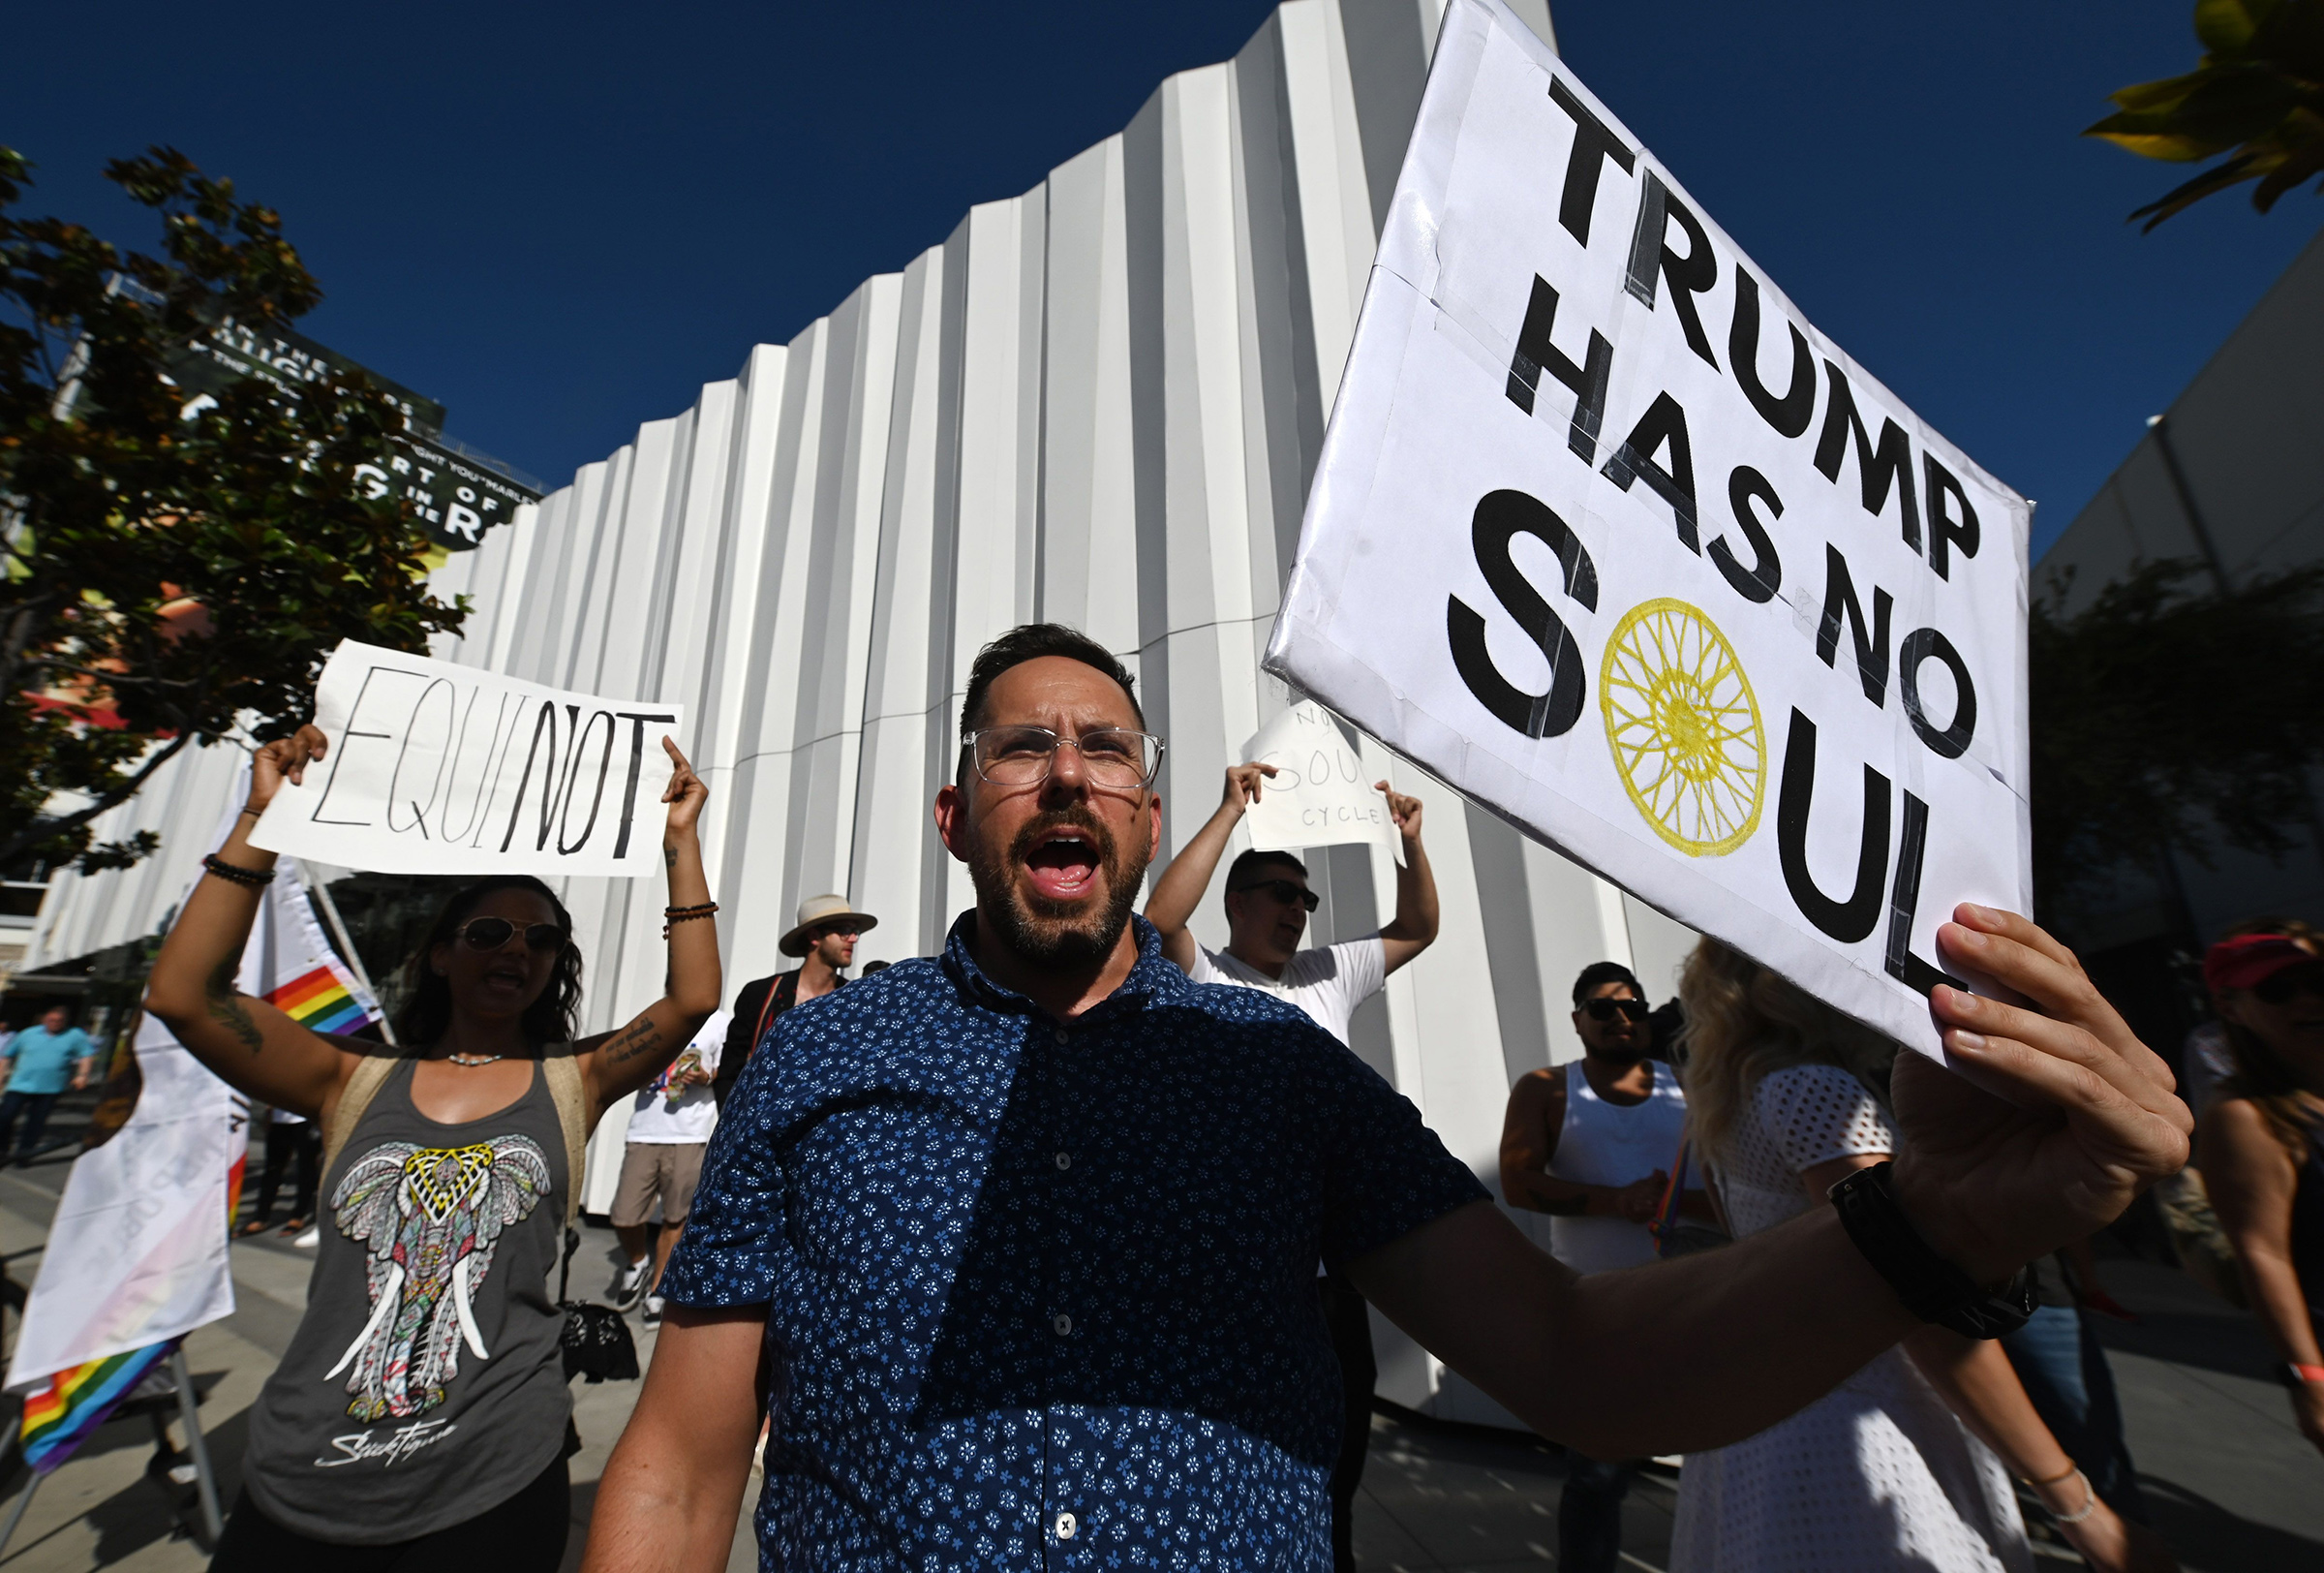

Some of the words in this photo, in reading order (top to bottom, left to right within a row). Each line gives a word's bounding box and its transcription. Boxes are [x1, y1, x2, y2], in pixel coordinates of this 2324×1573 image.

[456, 486, 499, 511] OF
[1548, 74, 1980, 582] TRUMP
[1506, 273, 1784, 602] HAS
[1817, 542, 1978, 759] NO
[312, 665, 676, 861] EQUINOT
[1302, 806, 1380, 826] CYCLE
[1448, 489, 1970, 996] SOUL
